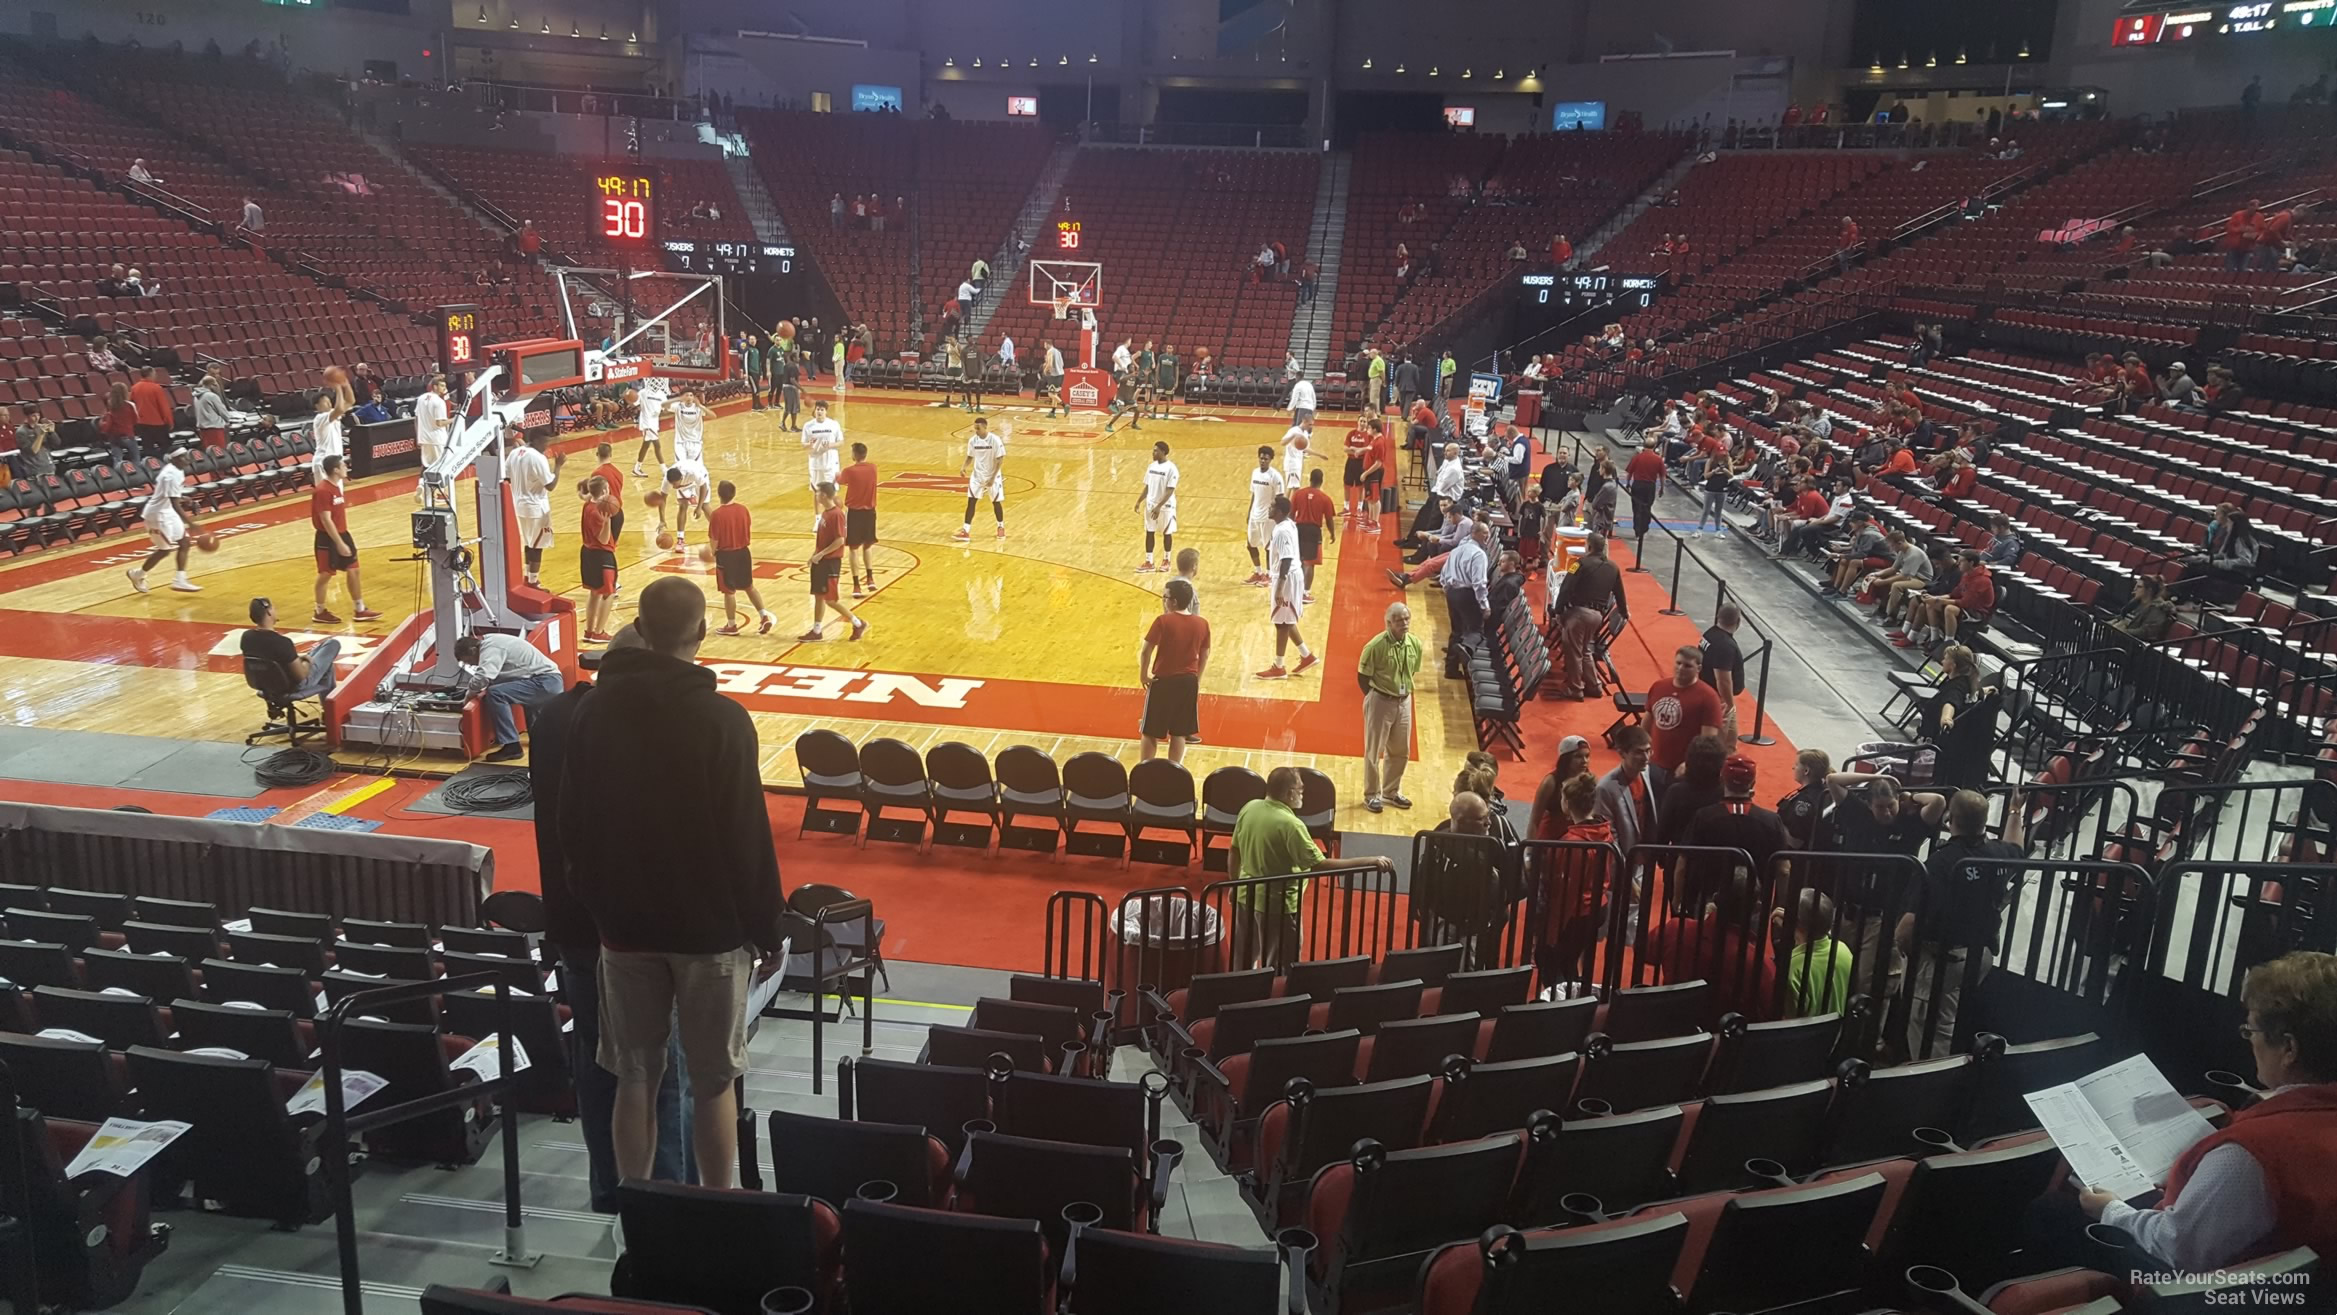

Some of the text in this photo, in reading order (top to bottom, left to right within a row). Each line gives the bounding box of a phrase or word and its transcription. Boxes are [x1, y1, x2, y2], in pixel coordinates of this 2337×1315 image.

[2228, 3, 2272, 19] 49:17
[597, 176, 650, 198] 49:17
[605, 200, 644, 238] 30
[1057, 222, 1081, 231] 49:17
[1061, 231, 1079, 248] 30
[716, 243, 747, 257] 49:17
[763, 247, 795, 257] HORNETS
[1523, 276, 1554, 285] HUSKERS
[1575, 276, 1606, 290] 49:17
[452, 336, 469, 360] 30
[1072, 390, 1096, 398] CASEY'S
[372, 438, 417, 459] HUSKERS
